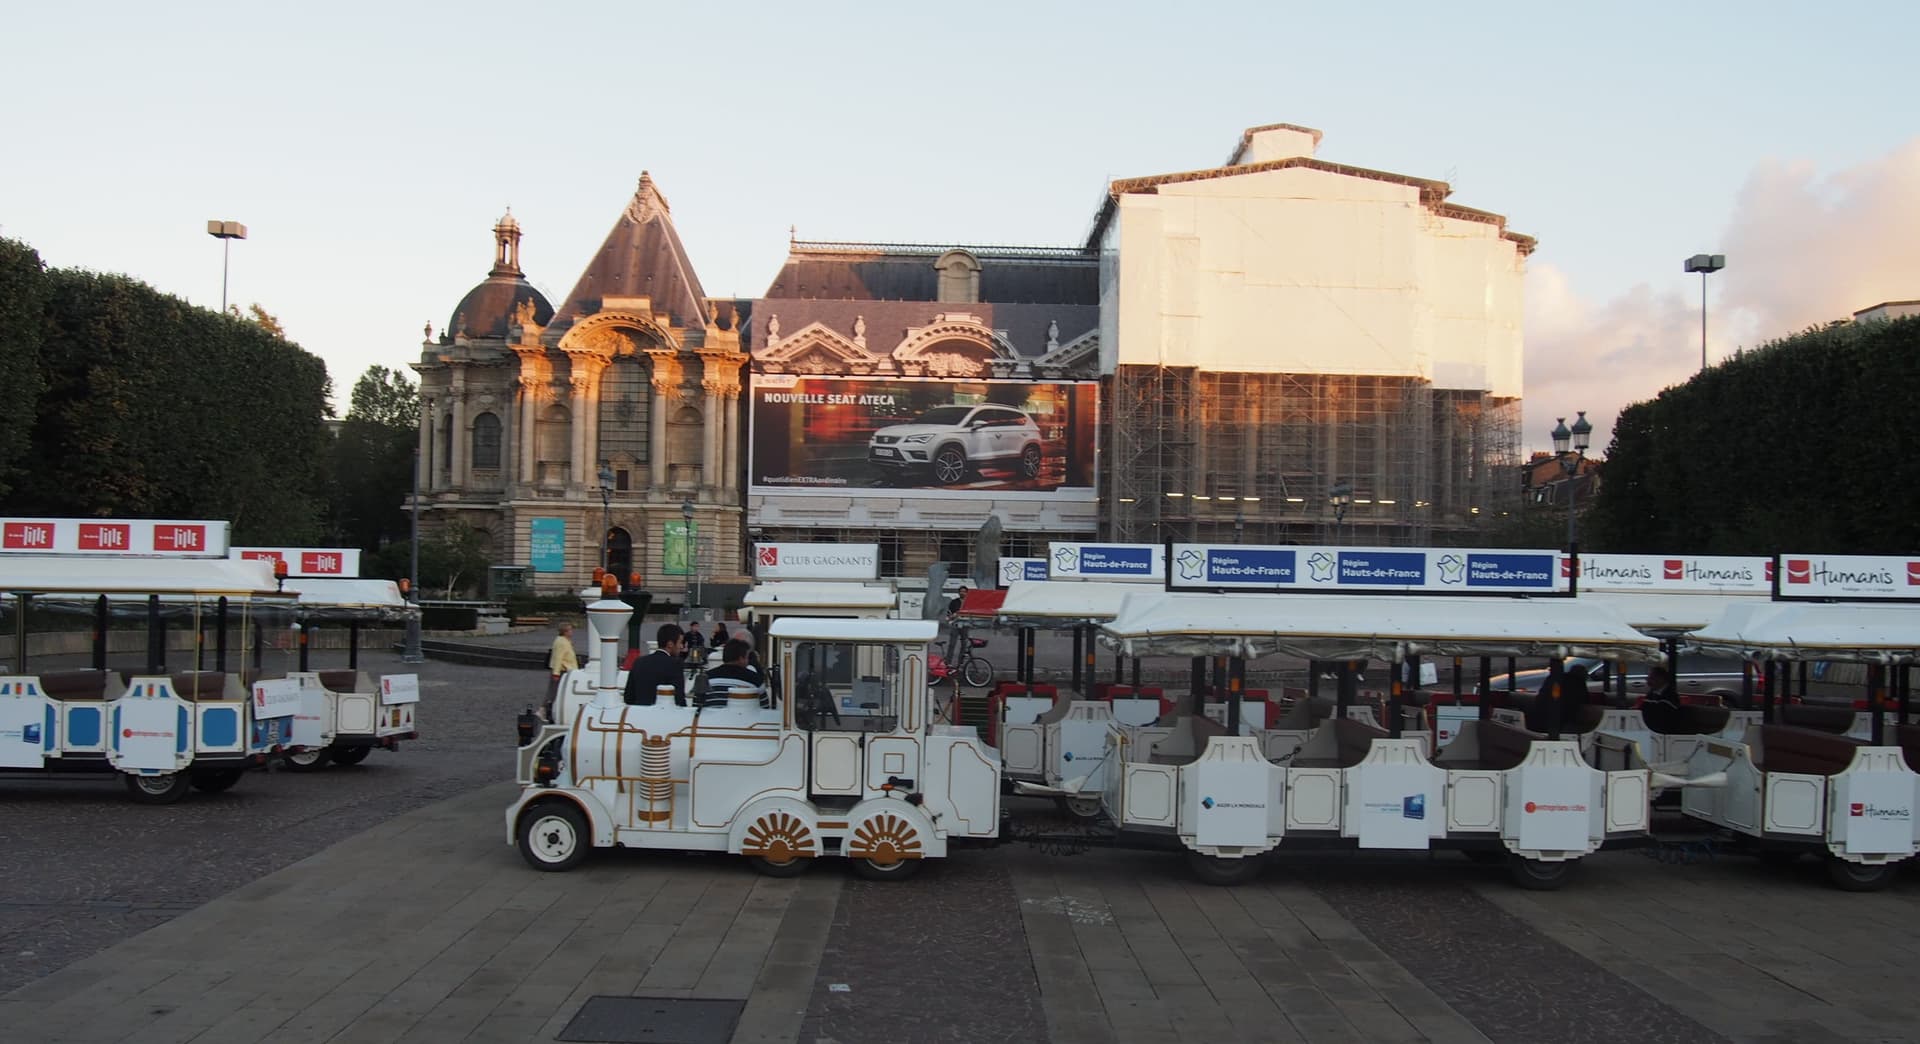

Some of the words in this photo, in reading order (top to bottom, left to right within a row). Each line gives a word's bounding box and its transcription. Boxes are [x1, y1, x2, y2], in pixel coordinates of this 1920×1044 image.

[764, 392, 824, 404] NOUVELLE
[826, 394, 857, 405] SEAT
[858, 394, 896, 406] ATECA
[782, 555, 811, 566] CLUB
[813, 555, 874, 567] GAGNANTS
[1082, 560, 1149, 570] Hauts-de-France
[1211, 556, 1240, 566] Région
[1342, 559, 1370, 568] Région
[1471, 561, 1499, 570] Région
[1211, 566, 1291, 576] Hauts-de-France
[1342, 567, 1421, 578] Hauts-de-France
[1583, 558, 1652, 580] Humanis
[1685, 560, 1753, 582] Humanis
[1812, 560, 1894, 586] Humanis
[1471, 570, 1549, 580] Hauts-de-France
